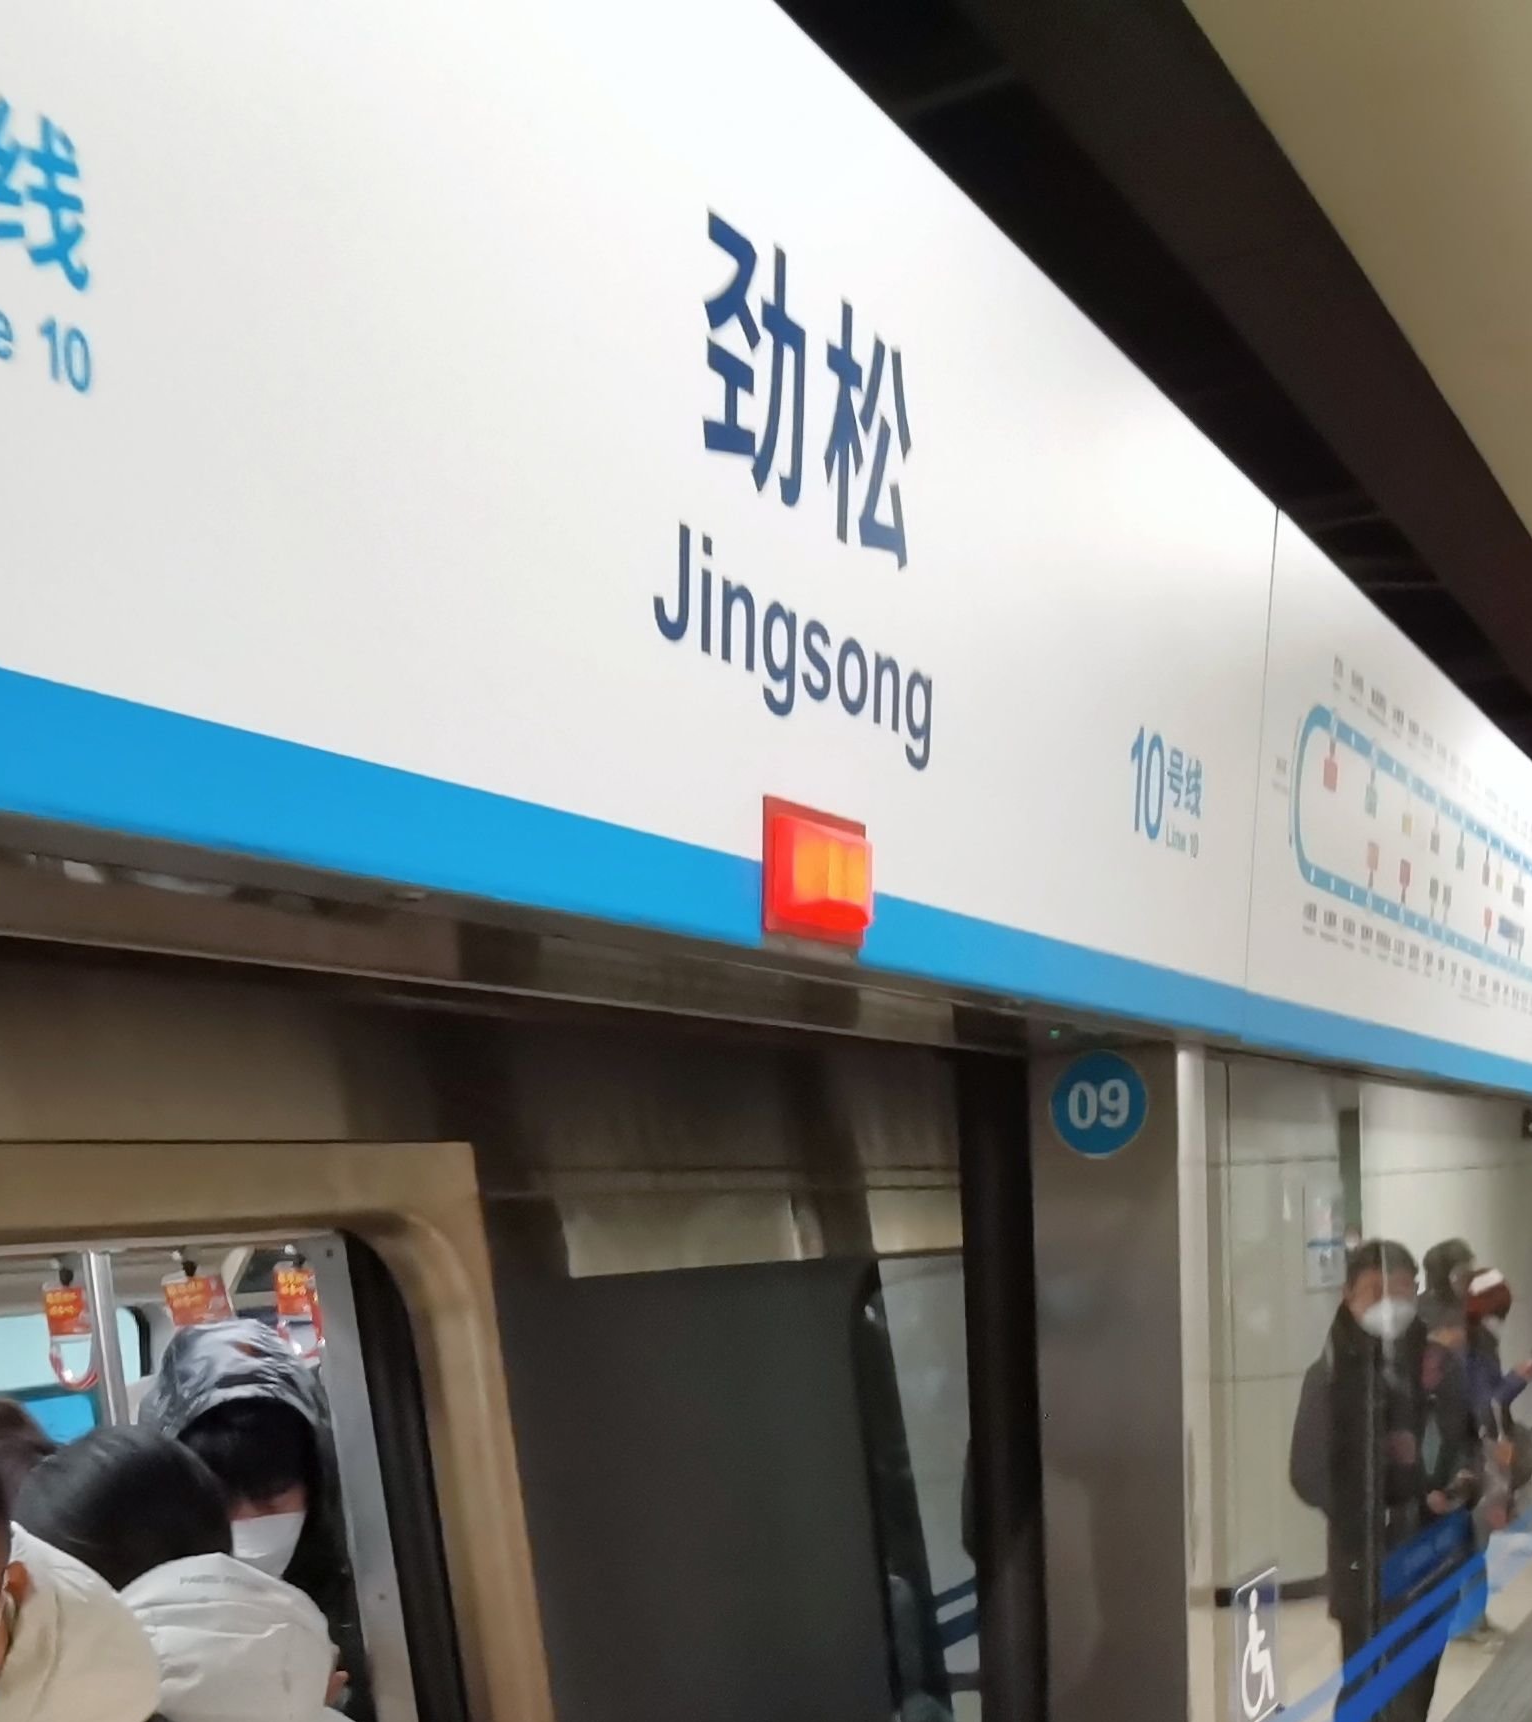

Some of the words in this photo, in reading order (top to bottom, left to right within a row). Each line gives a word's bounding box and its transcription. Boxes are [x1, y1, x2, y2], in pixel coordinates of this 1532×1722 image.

[37, 314, 93, 394] 10
[701, 206, 912, 571] 劲松
[652, 521, 934, 772] Jingsong
[1131, 726, 1202, 840] 10号线
[1067, 1077, 1130, 1130] 09
